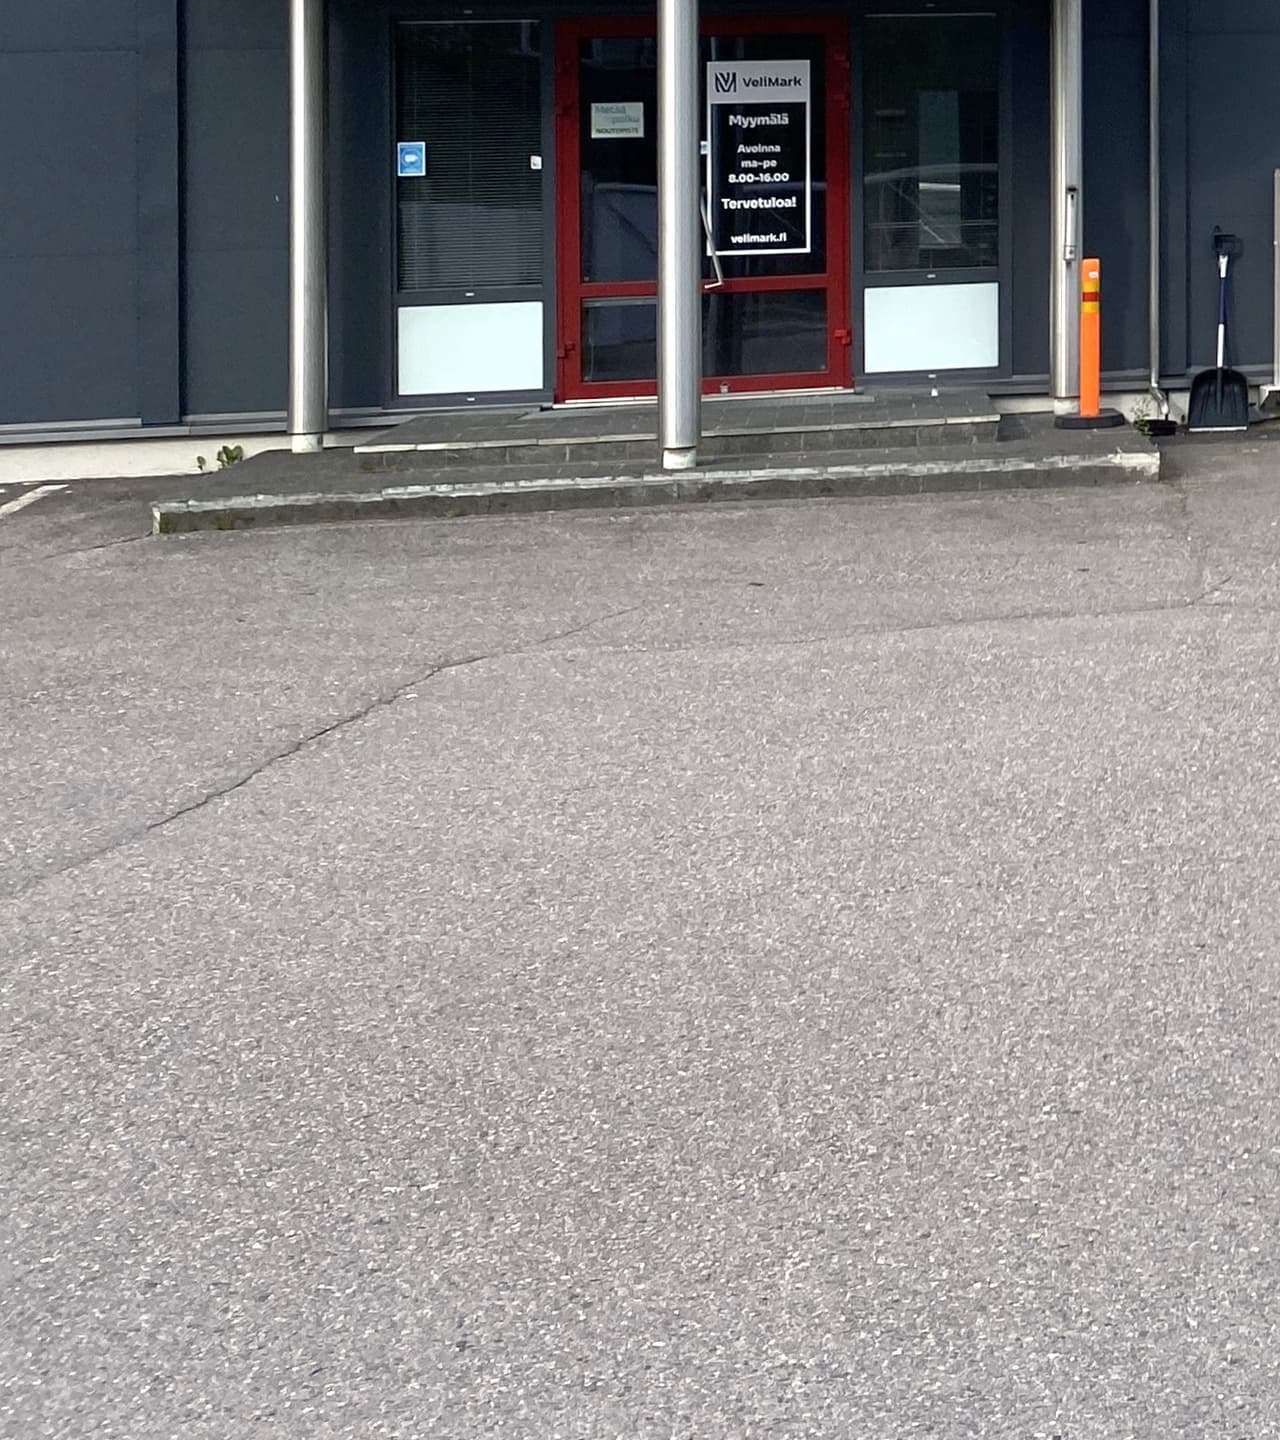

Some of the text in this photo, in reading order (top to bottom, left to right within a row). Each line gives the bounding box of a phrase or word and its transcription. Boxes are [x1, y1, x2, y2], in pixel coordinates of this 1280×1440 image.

[742, 75, 803, 88] VeliMark
[728, 112, 789, 129] Myymälä
[737, 143, 781, 153] Avoinna
[740, 159, 777, 169] ma-pe
[728, 172, 790, 183] 8.00-16.00
[720, 196, 797, 210] Tervetuloa!
[730, 231, 787, 244] velimark.fi
